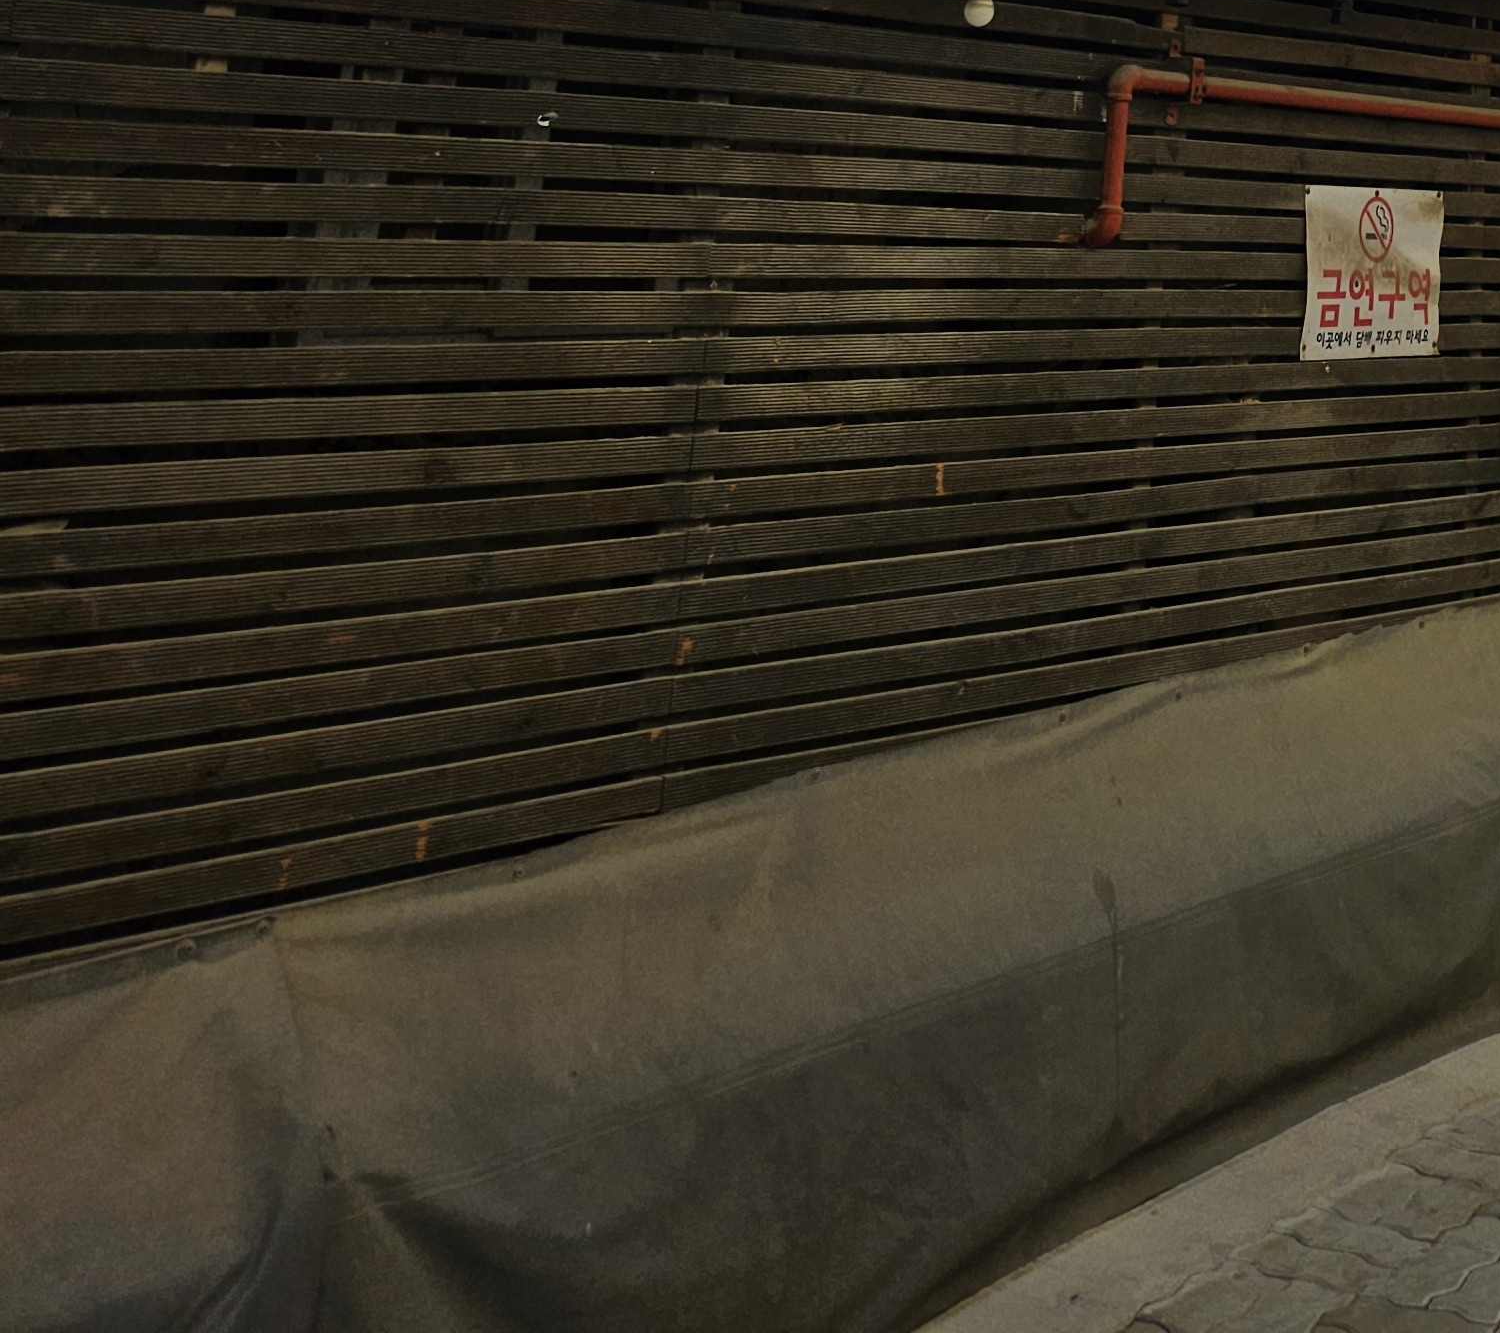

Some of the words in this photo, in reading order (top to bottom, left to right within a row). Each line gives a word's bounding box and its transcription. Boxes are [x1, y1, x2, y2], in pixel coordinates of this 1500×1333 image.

[1316, 268, 1431, 329] 금연구역
[1316, 331, 1352, 350] 이곳에서
[1356, 330, 1373, 348] 담배
[1375, 329, 1403, 345] 피우지
[1406, 329, 1429, 344] 마세요
